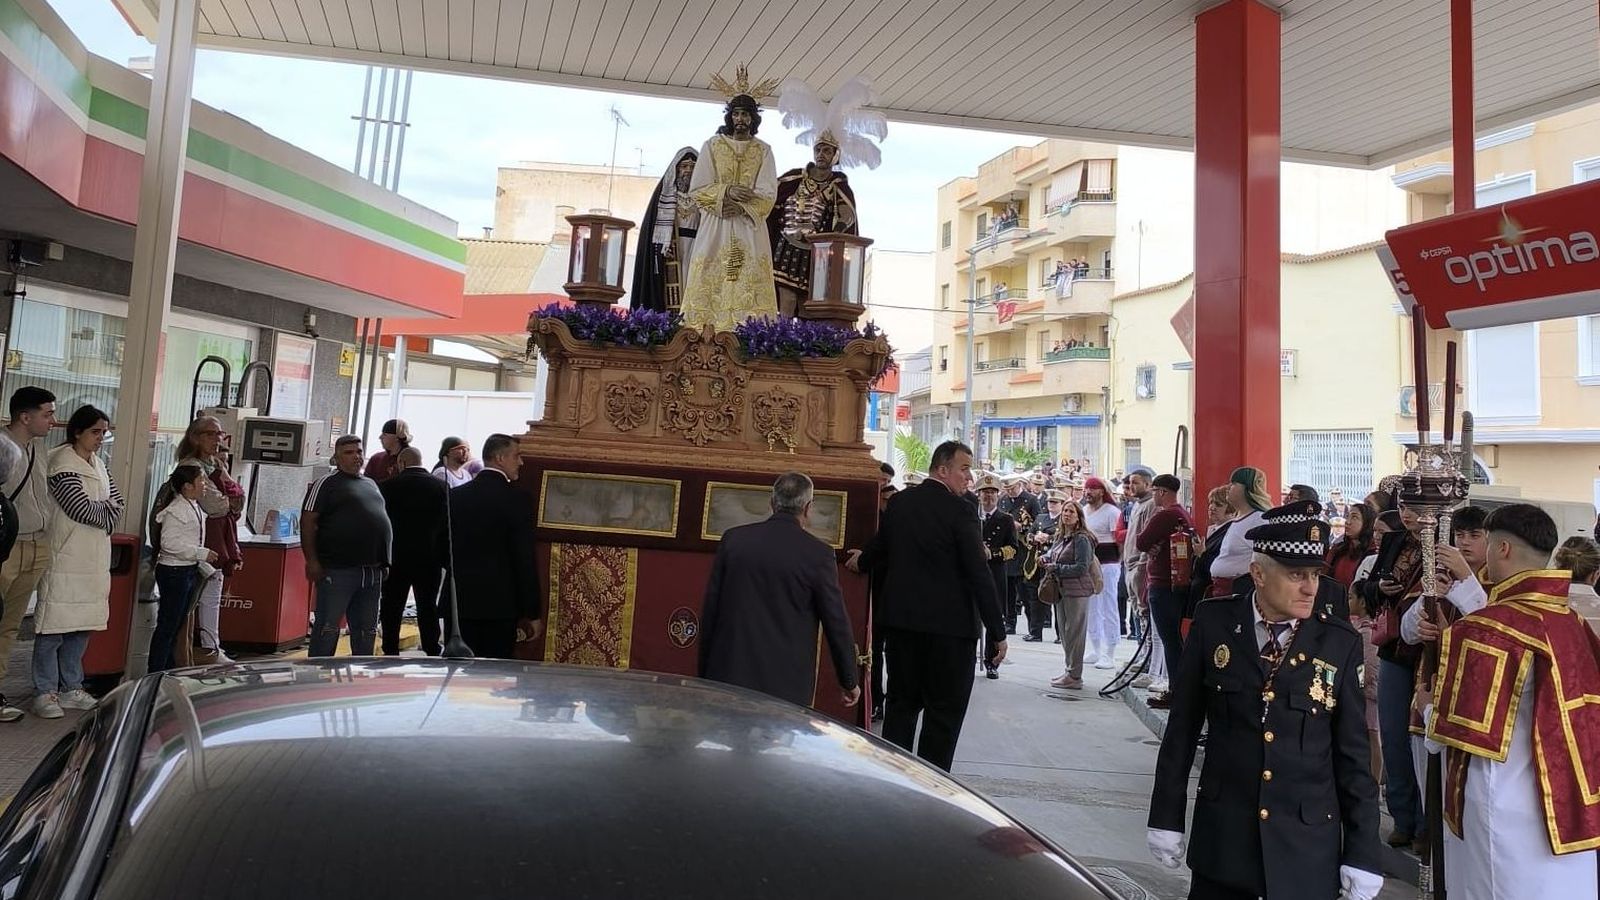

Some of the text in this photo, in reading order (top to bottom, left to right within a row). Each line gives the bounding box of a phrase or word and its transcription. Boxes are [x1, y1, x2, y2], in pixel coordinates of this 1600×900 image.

[1429, 246, 1453, 257] CEPSA
[1444, 231, 1600, 292] optima
[1390, 268, 1412, 295] 5
[219, 598, 253, 609] ima
